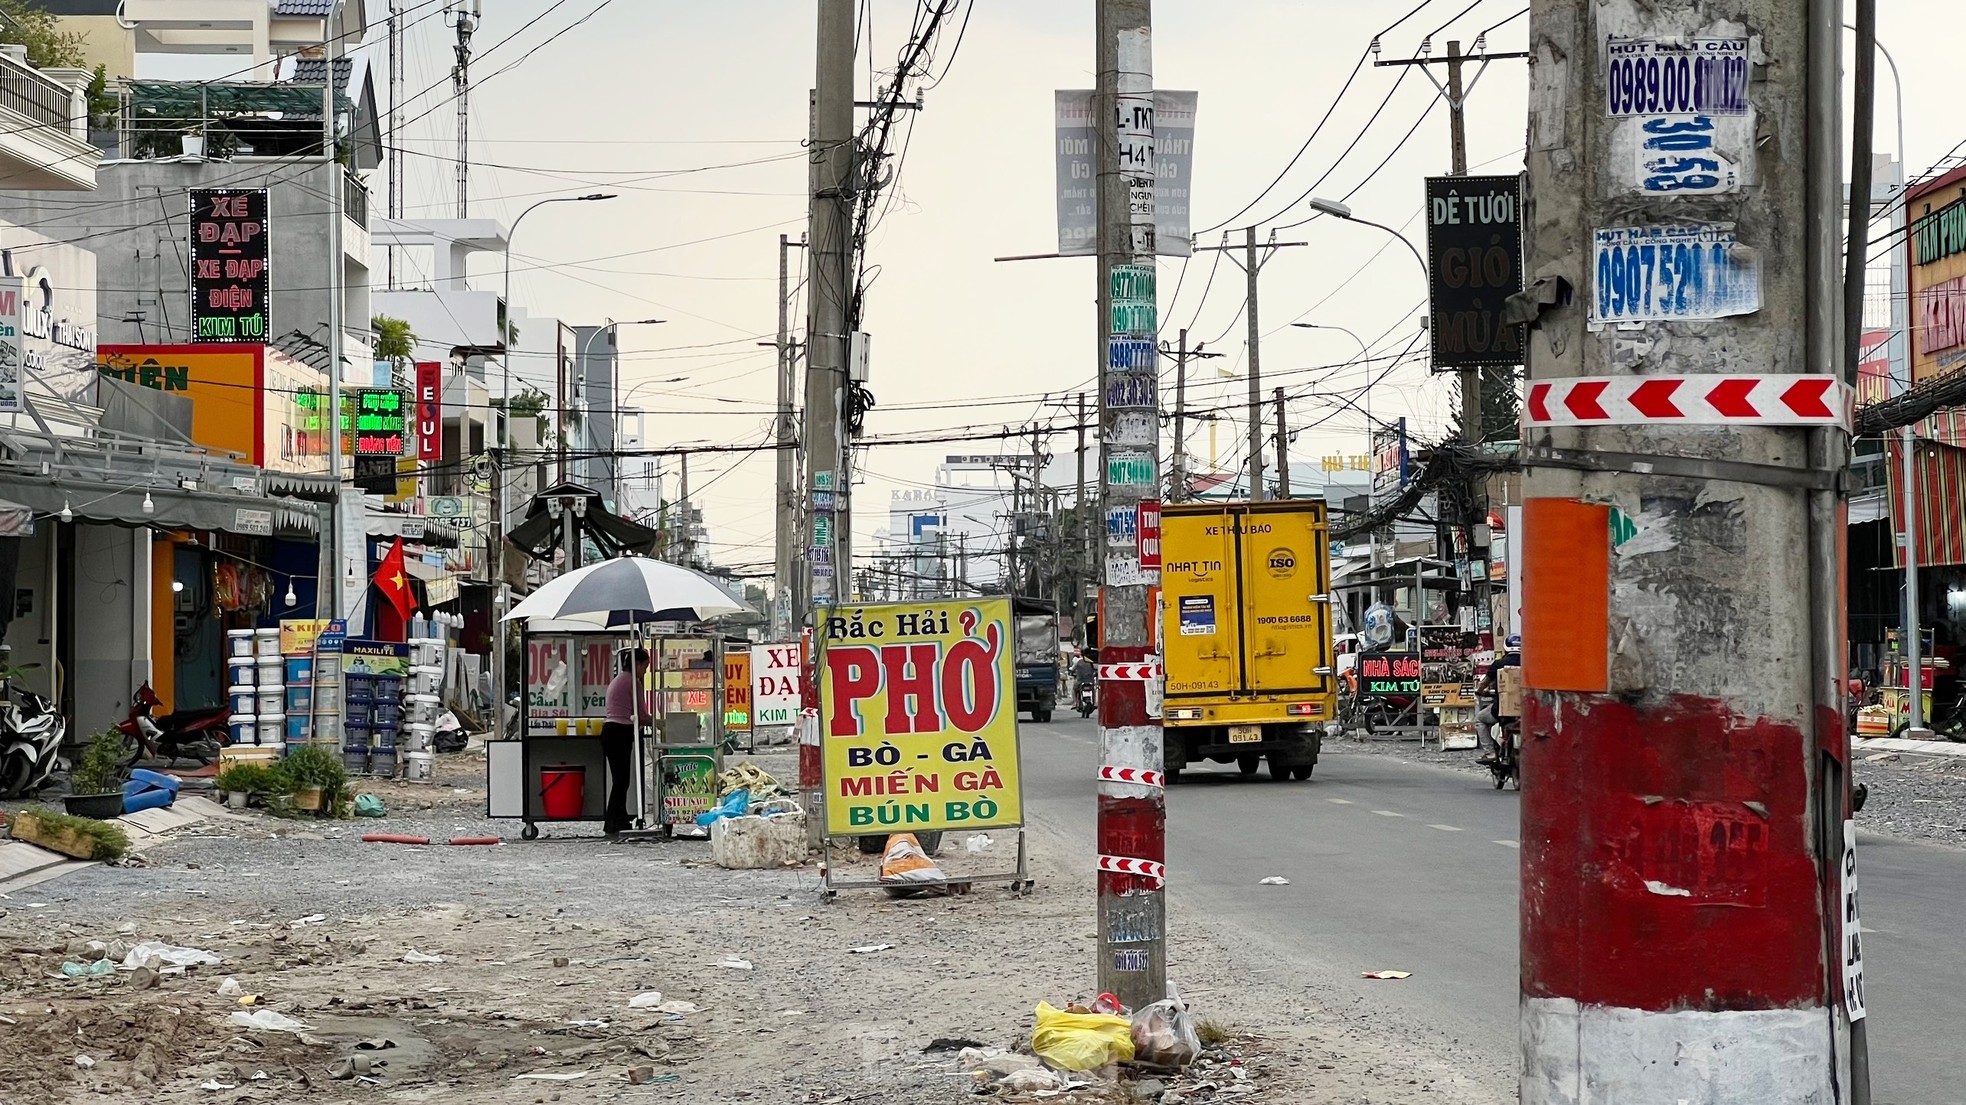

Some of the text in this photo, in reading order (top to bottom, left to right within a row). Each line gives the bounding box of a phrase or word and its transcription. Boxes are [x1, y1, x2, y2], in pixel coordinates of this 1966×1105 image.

[210, 197, 248, 217] XE
[1433, 190, 1514, 225] DÊ TƯƠI
[198, 222, 261, 247] ĐẠP
[198, 259, 263, 282] XE ĐẠP
[209, 284, 252, 311] ĐIỆN
[198, 313, 263, 336] KIM TÚ
[1205, 527, 1219, 535] XE
[1251, 523, 1272, 533] BÁO
[1269, 558, 1295, 568] ISO
[829, 609, 950, 640] Bắc Hải
[1257, 615, 1312, 625] 1900 63 6688
[353, 646, 395, 656] MAXILITE
[768, 648, 799, 668] XE
[826, 607, 1005, 738] PHỞ
[1363, 656, 1390, 677] NHÀ
[760, 676, 801, 700] ĐẠ
[1370, 679, 1420, 692] KIM TÚ
[760, 708, 787, 721] KIM
[848, 741, 900, 767] BÒ
[942, 736, 993, 762] GÀ
[840, 765, 1004, 797] MIẾN GÀ
[849, 794, 998, 826] BÚN BÒ
